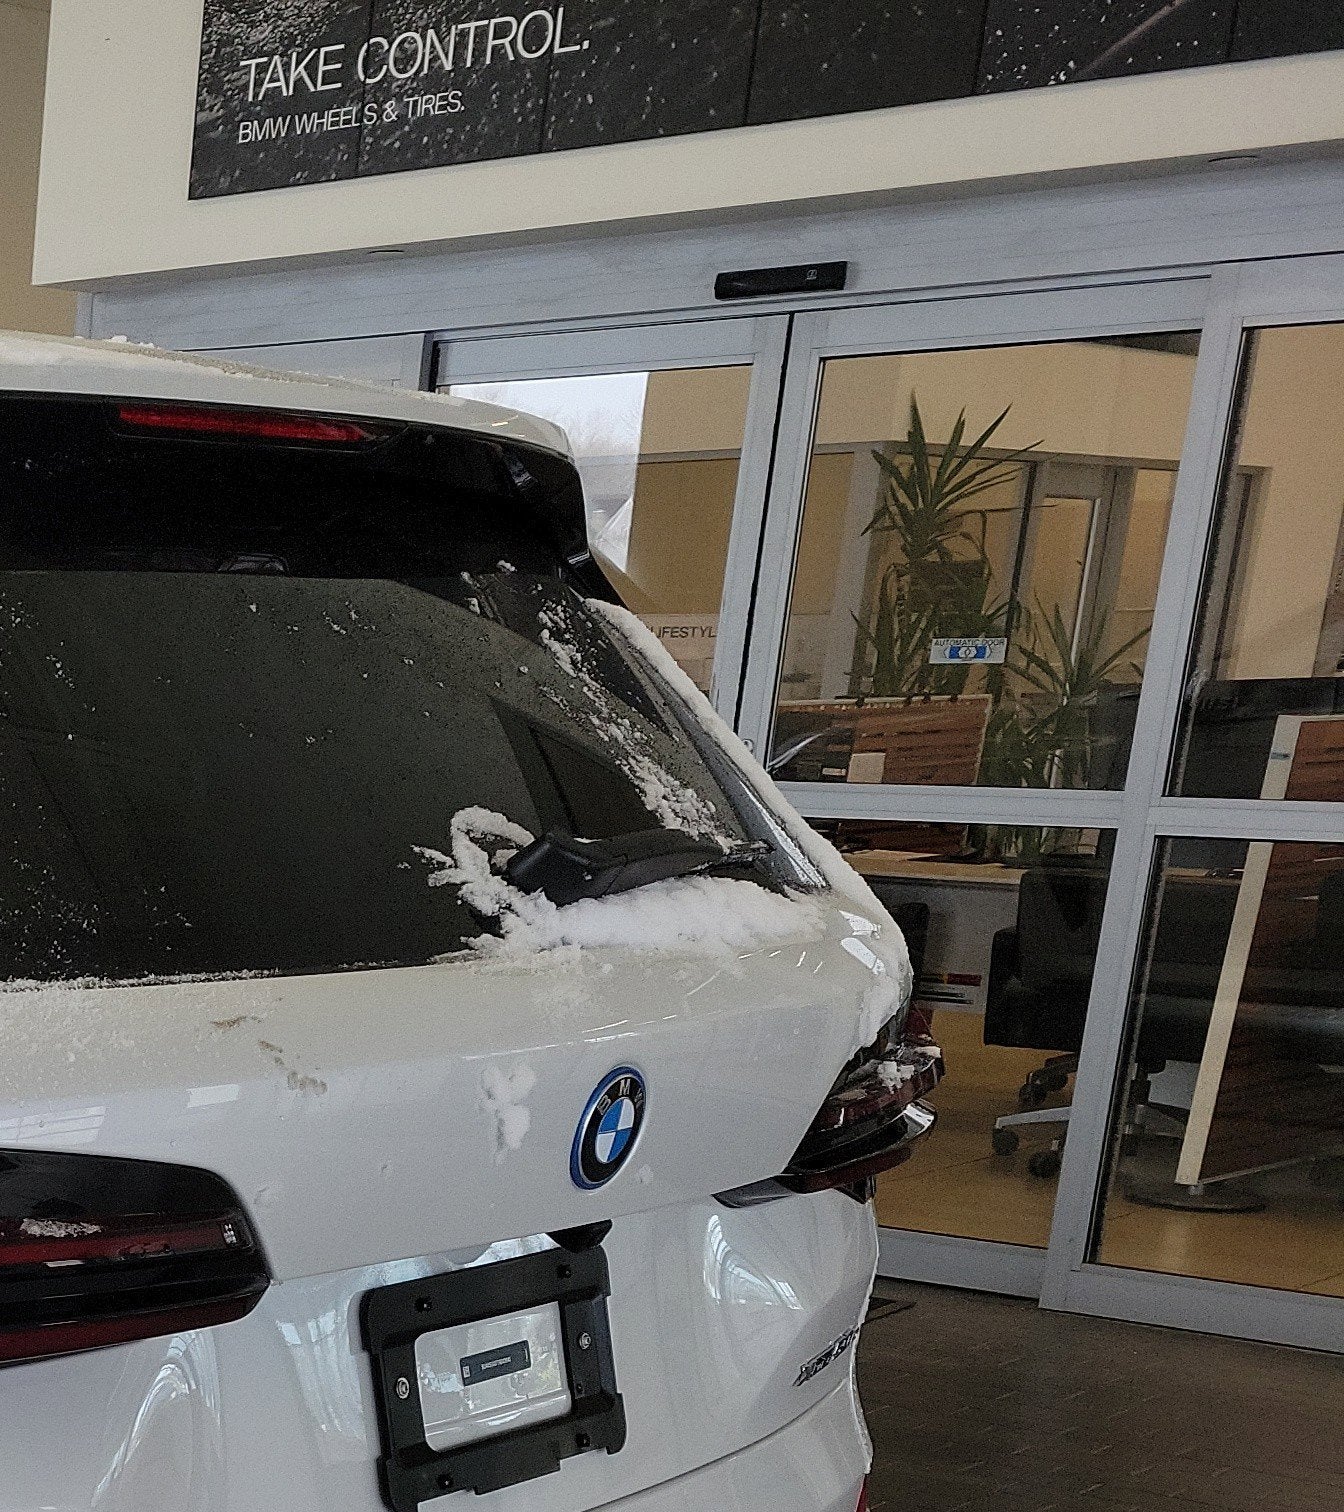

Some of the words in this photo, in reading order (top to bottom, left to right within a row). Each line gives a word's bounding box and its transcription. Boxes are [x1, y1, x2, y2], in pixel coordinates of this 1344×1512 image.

[239, 43, 346, 102] TAKE
[357, 7, 590, 85] CONTROL.
[238, 114, 291, 144] BMW
[295, 104, 378, 136] WHEELS
[382, 99, 398, 123] &
[404, 90, 465, 119] TIRES.
[933, 638, 980, 647] AUTOMATIC
[982, 638, 1006, 647] DOOR
